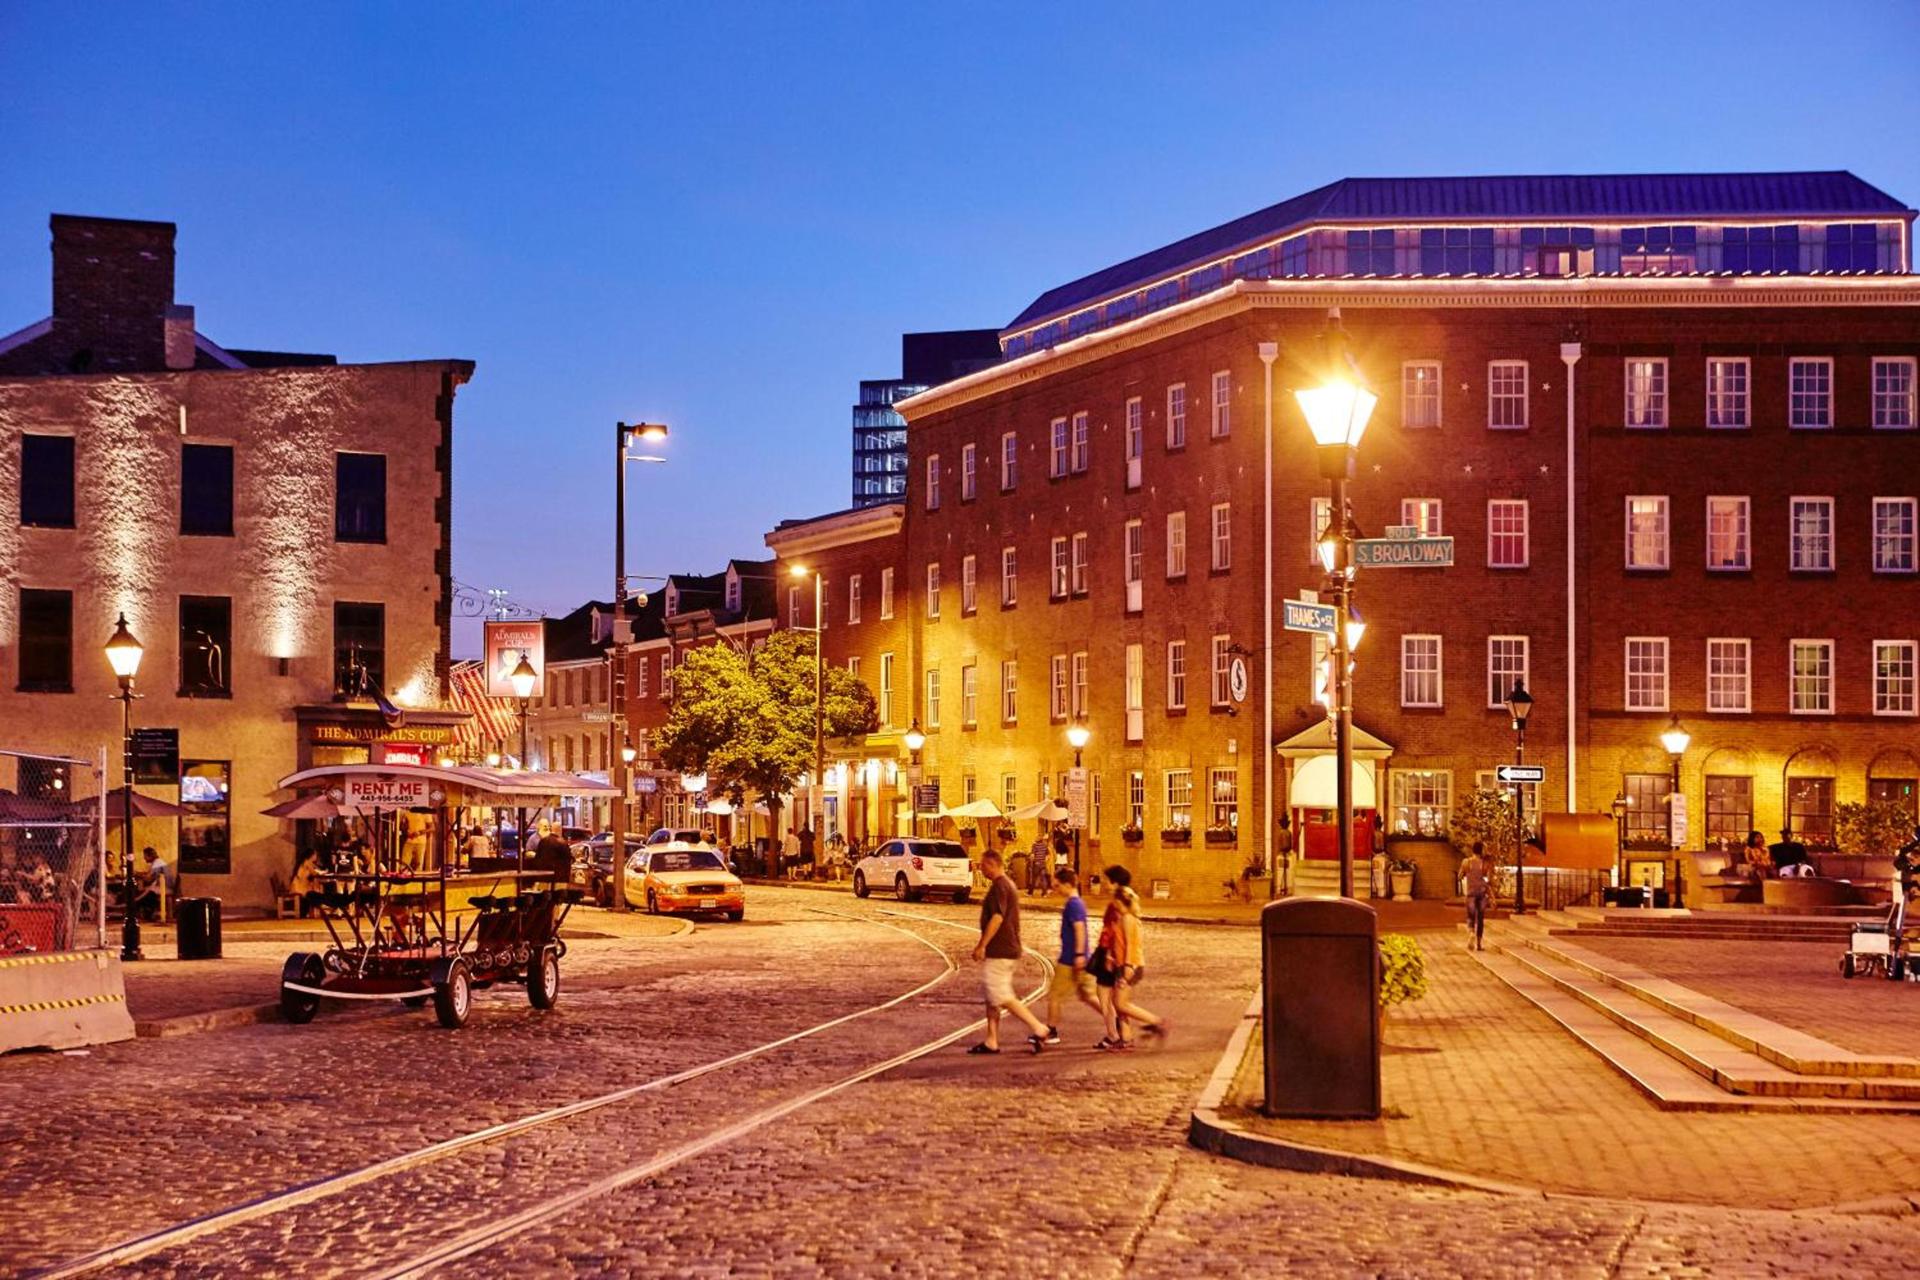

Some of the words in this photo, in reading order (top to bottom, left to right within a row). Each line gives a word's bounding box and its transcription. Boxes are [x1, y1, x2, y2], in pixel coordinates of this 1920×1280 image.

[1373, 542, 1451, 562] BROADWAY
[1287, 605, 1321, 628] THAMES
[504, 640, 524, 648] CUP
[316, 727, 342, 738] THE
[345, 728, 416, 740] ADMIRAL'S
[420, 729, 445, 741] CUP
[352, 783, 395, 795] RENT
[400, 783, 422, 795] ME
